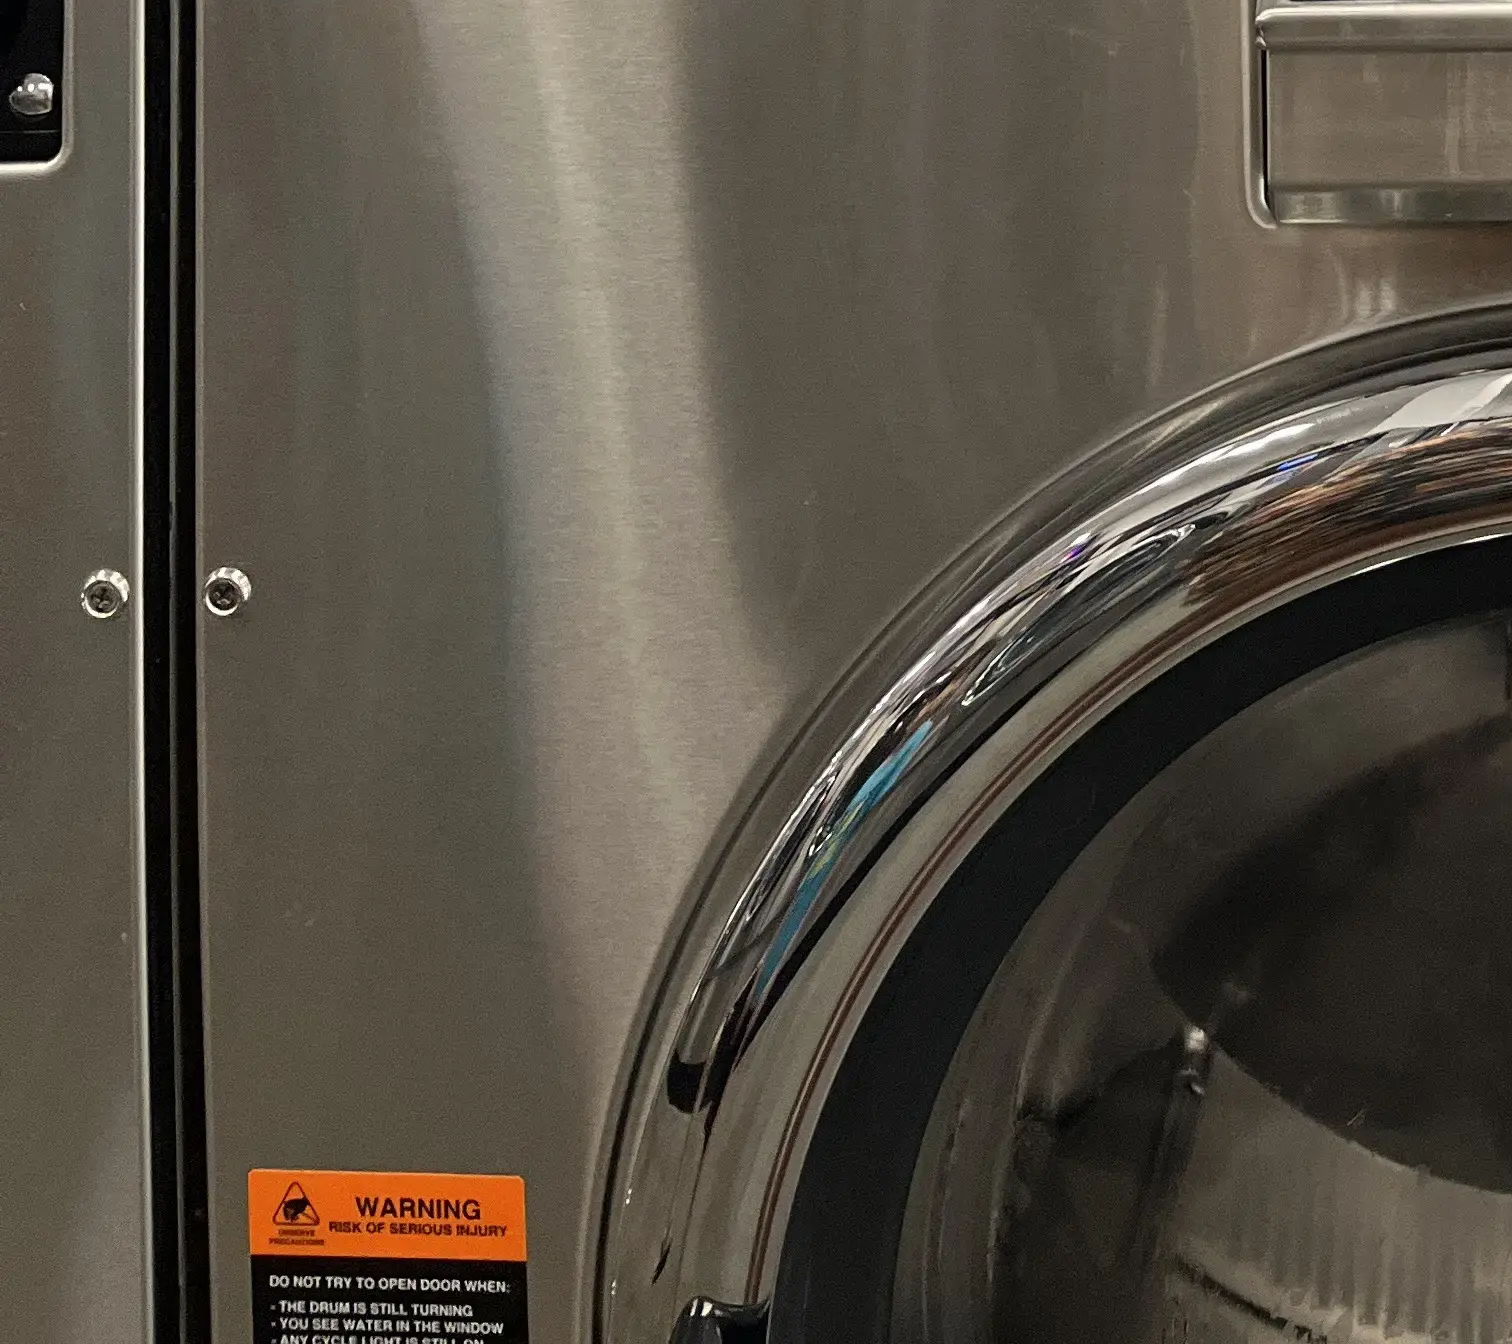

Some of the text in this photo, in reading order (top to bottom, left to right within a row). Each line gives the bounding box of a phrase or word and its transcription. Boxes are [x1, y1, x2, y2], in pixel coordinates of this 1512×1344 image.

[355, 1196, 481, 1220] WARNING
[329, 1221, 362, 1233] RISK
[366, 1222, 384, 1234] OF
[390, 1222, 452, 1236] SERIOUS
[456, 1224, 507, 1237] INJURY
[269, 1275, 510, 1293] DO NOT TRY TO OPEN DOOR WHEN:
[279, 1300, 473, 1317] THE DRUM IS STILL TURNING
[280, 1317, 504, 1334] YOU SEE WATER IN THE WINDOW
[280, 1334, 309, 1344] ANY
[312, 1335, 358, 1344] CYCLE
